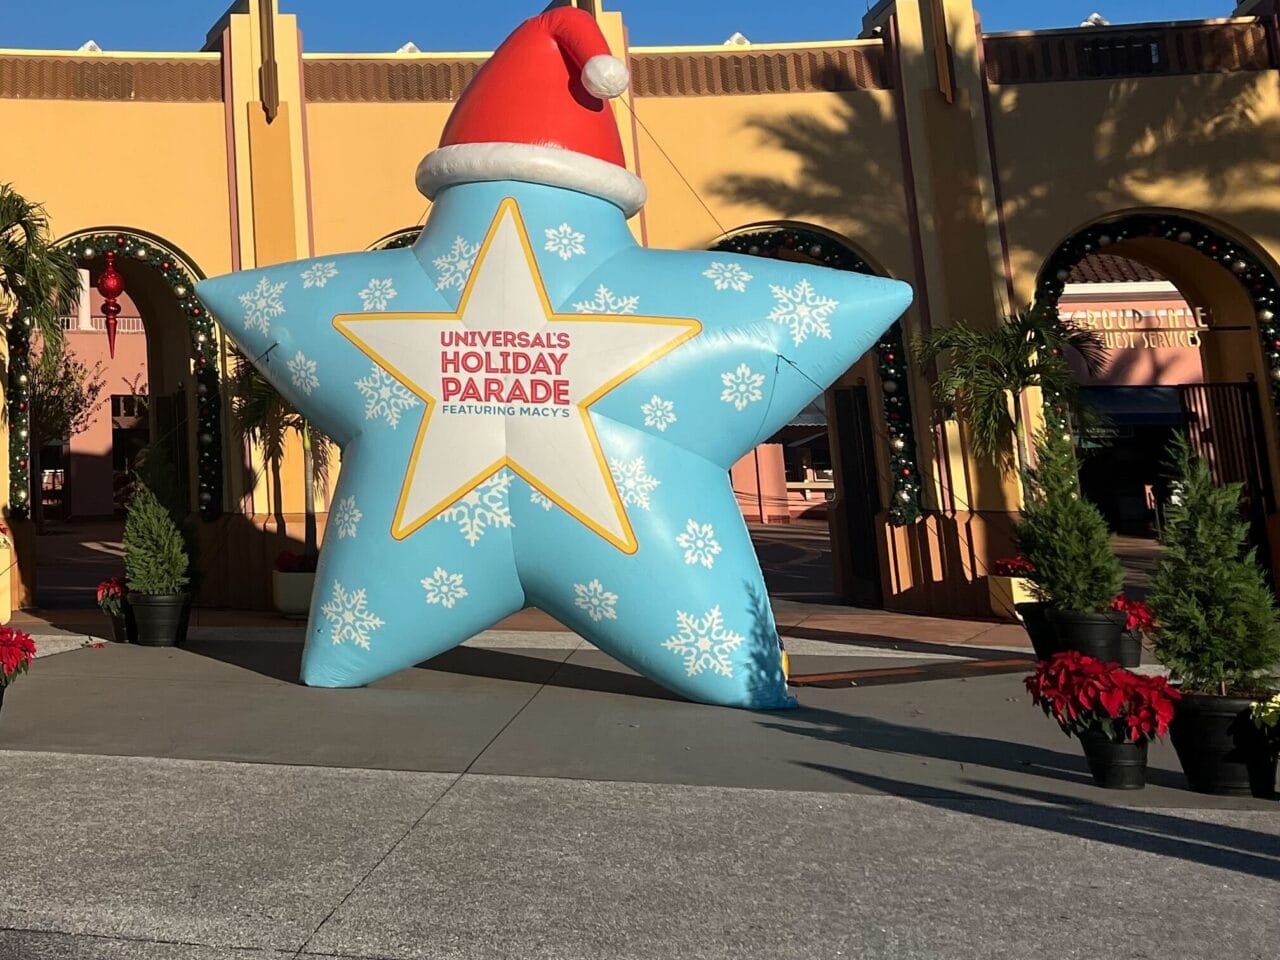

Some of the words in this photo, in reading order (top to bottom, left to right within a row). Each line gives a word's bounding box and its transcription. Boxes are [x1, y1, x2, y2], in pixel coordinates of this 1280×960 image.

[1153, 307, 1217, 329] SALE
[440, 330, 570, 349] UNIVERSAL'S
[1097, 330, 1135, 349] UEST
[1142, 330, 1201, 349] SERVICES
[441, 351, 568, 375] HOLIDAY
[441, 377, 570, 405] PARADE
[442, 405, 515, 416] FEATURING
[520, 406, 570, 418] MACY'S
